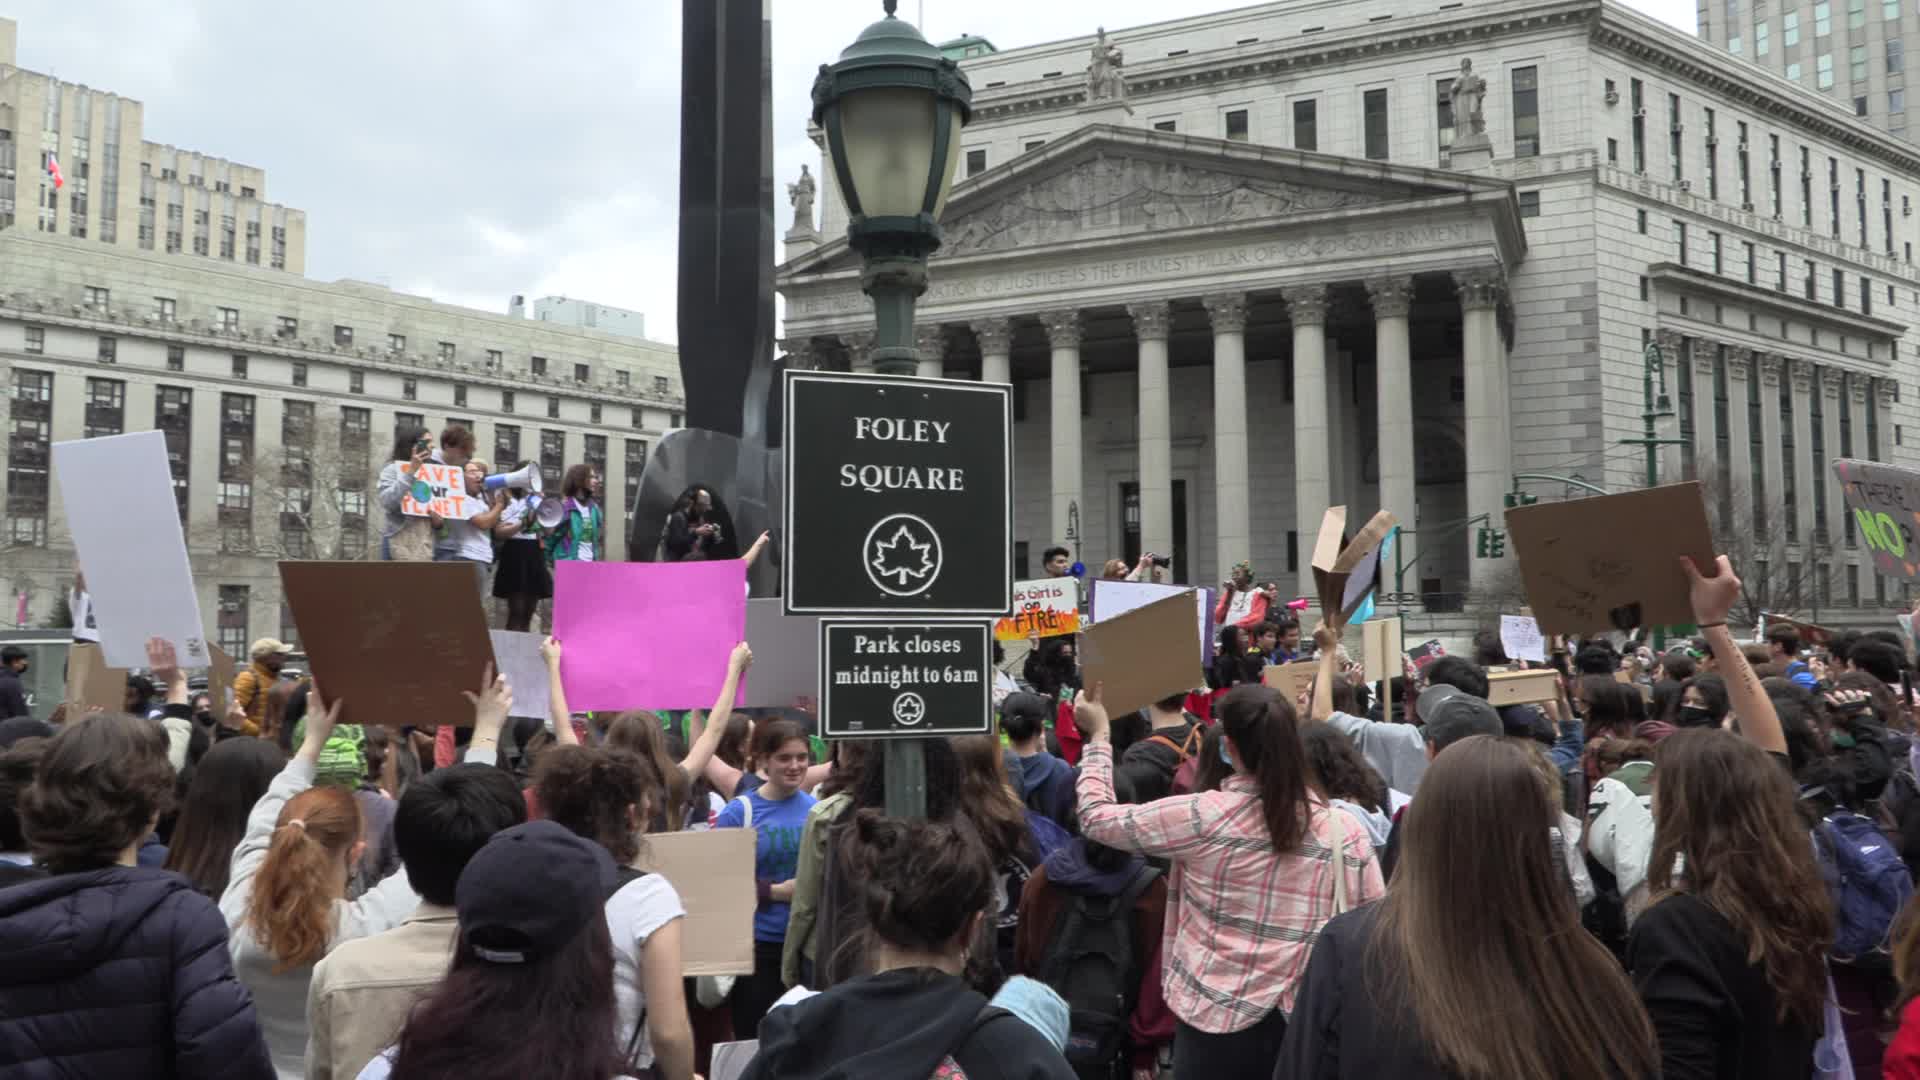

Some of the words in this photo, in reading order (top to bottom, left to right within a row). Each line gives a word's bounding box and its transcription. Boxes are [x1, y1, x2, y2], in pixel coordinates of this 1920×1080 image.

[1007, 270, 1066, 291] JUSTICE
[1073, 266, 1086, 283] IS
[1088, 262, 1121, 281] THE
[1126, 256, 1194, 278] FIRMEST
[1199, 250, 1248, 268] PILLAR
[1342, 223, 1473, 252] GOVERNMENT
[854, 416, 950, 443] FOLEY
[840, 463, 964, 493] SQUARE
[1855, 507, 1905, 559] NO
[1015, 609, 1058, 633] FIRE
[854, 634, 900, 654] Park
[904, 634, 961, 654] closes
[835, 665, 920, 689] midnight
[923, 666, 940, 683] to
[943, 665, 979, 683] 6am
